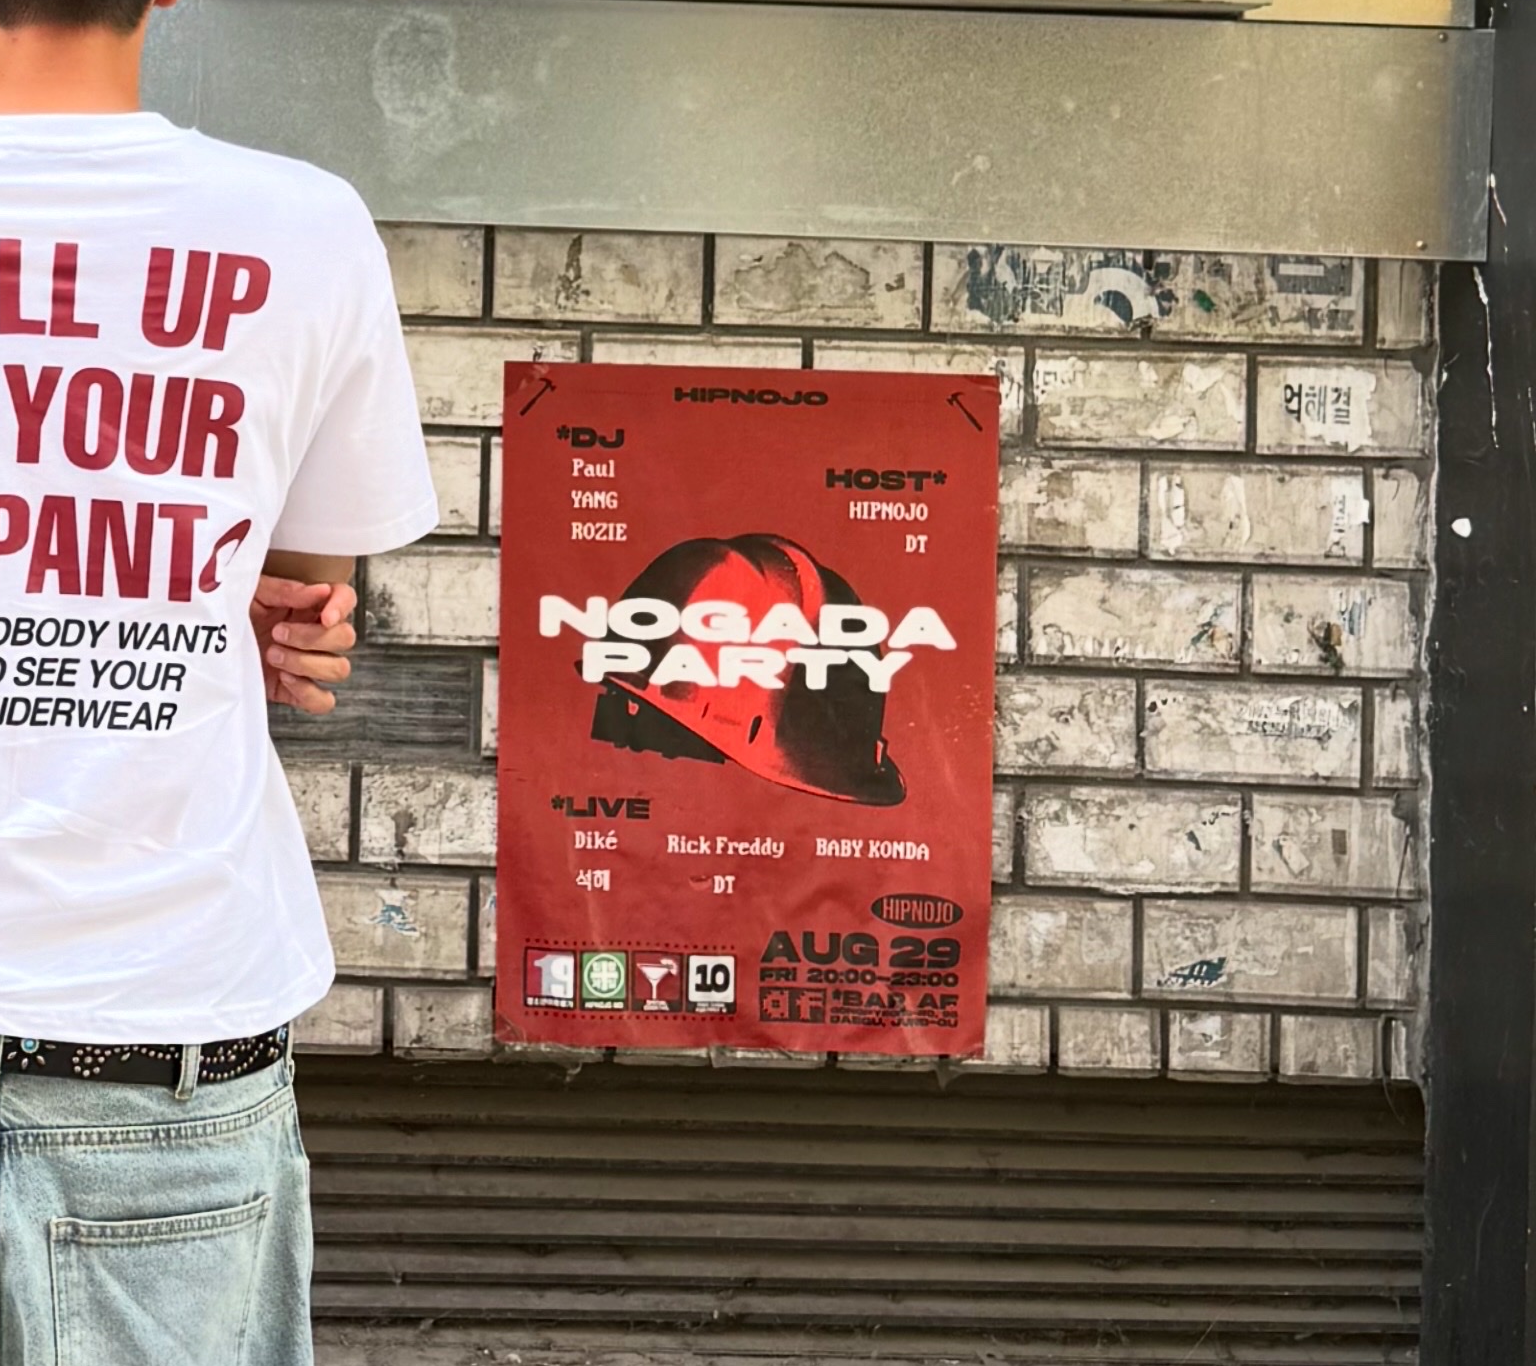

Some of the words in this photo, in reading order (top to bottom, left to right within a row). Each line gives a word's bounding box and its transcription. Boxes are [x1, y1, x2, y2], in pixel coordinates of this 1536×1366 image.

[141, 248, 271, 351] UP
[674, 387, 828, 406] HIPNOJO
[4, 364, 246, 478] YOUR
[572, 458, 615, 478] Paul
[571, 490, 618, 510] YANG
[849, 501, 928, 522] HIPNOJO
[571, 522, 628, 542] ROZIE
[905, 534, 928, 553] DT
[539, 595, 957, 650] NOGADA
[117, 622, 228, 654] WANTS
[13, 658, 78, 689] SEE
[89, 663, 186, 693] YOUR
[582, 641, 914, 693] PARTY
[574, 830, 619, 851] Diké
[667, 835, 710, 855] Rick
[715, 837, 785, 858] Freddy
[816, 838, 862, 859] BABY
[868, 840, 930, 861] KONDA
[713, 875, 736, 894] DT
[882, 898, 954, 923] HIPNOJO
[760, 930, 880, 967] AUG
[889, 936, 961, 968] 29
[694, 963, 731, 994] 10
[759, 967, 797, 982] FRI
[918, 992, 960, 1010] AF
